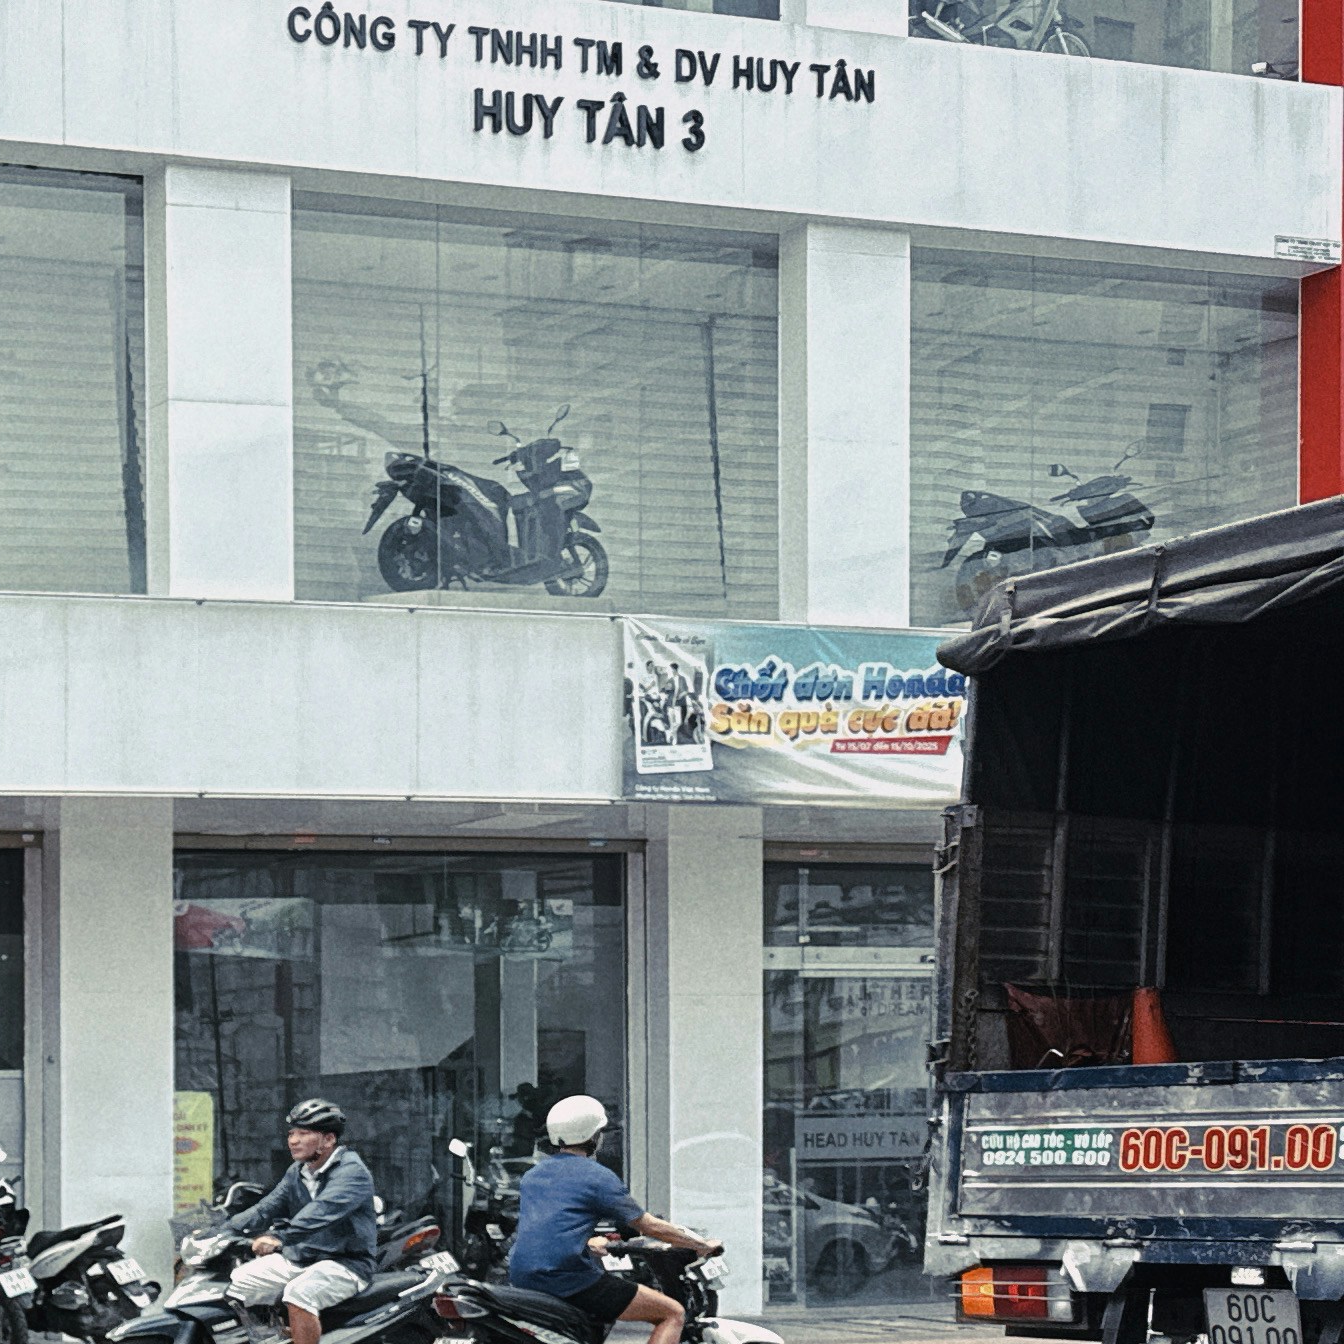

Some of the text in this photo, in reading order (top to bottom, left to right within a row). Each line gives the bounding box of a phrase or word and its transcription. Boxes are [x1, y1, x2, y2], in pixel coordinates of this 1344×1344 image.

[287, 1, 876, 103] CÔNG TY TNHH TM & DV HUY TÂN
[472, 88, 706, 152] HUY TÂN 3
[714, 660, 967, 703] Chốt đơn Honda
[712, 703, 771, 735] Săn
[779, 703, 838, 741] quà
[847, 704, 900, 739] cực
[803, 1132, 848, 1148] HEAD
[852, 1131, 884, 1147] HUY
[1030, 1150, 1066, 1165] 500
[1071, 1150, 1110, 1166] 600
[1120, 1125, 1336, 1172] 60C-091.00
[1226, 1294, 1276, 1323] 60C
